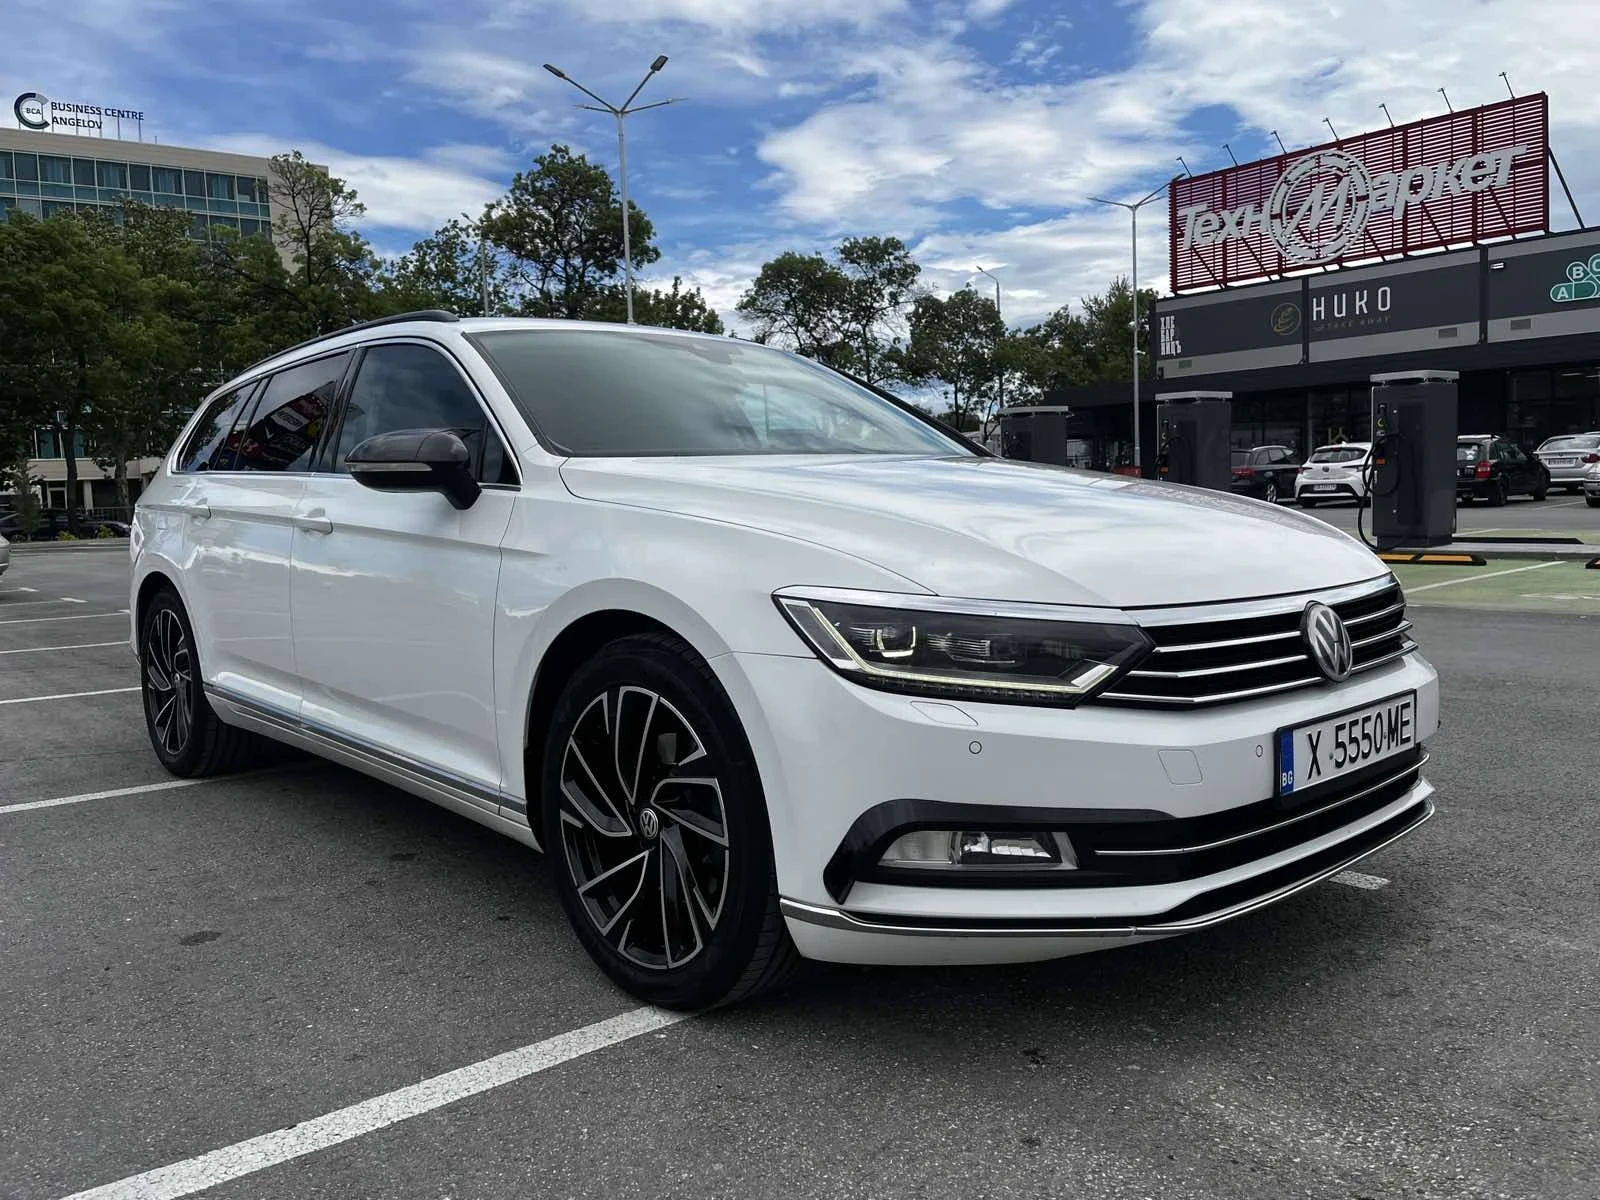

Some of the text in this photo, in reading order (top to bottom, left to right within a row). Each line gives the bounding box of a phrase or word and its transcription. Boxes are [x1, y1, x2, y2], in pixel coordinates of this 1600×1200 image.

[25, 107, 42, 115] BCA
[51, 101, 145, 121] BUSINESS CENTRE
[51, 115, 103, 130] ANGELOV
[1334, 711, 1384, 769] 5550
[1387, 701, 1411, 751] ME
[1281, 770, 1294, 788] BG
